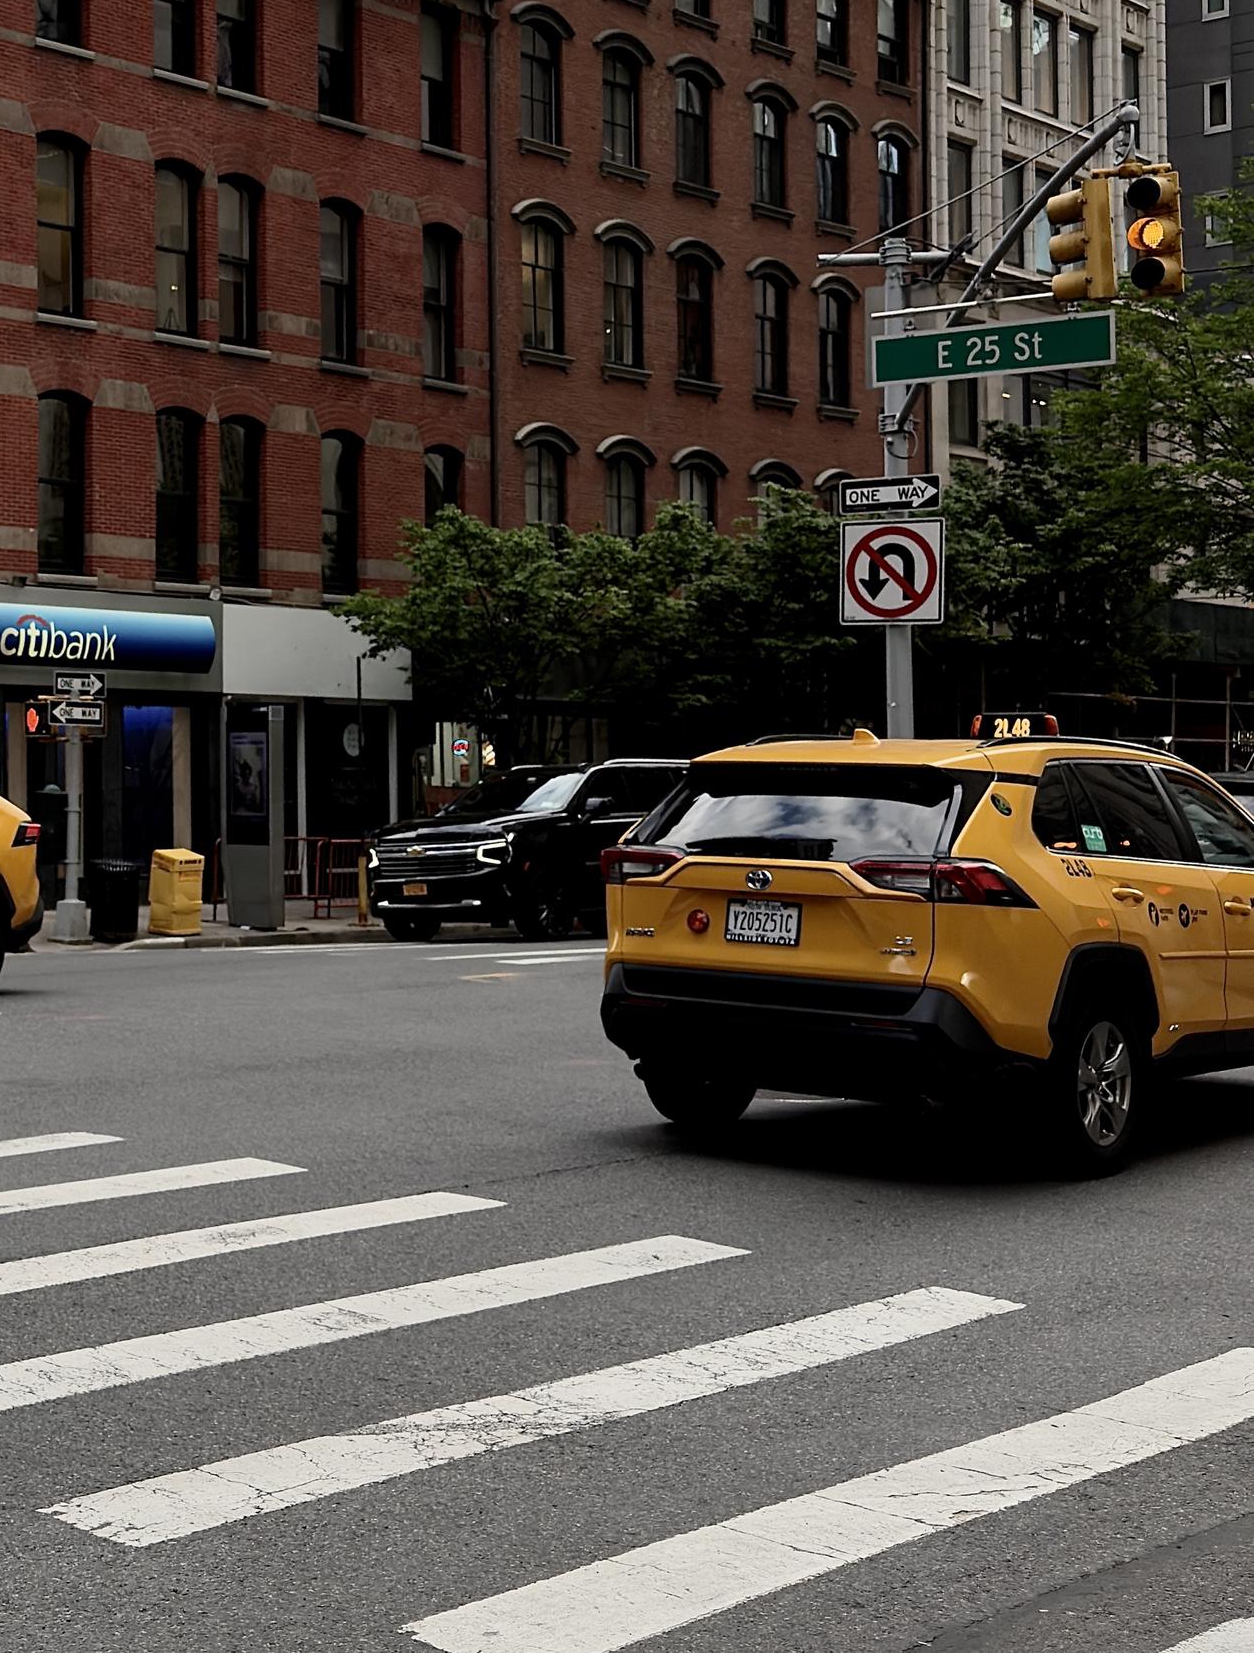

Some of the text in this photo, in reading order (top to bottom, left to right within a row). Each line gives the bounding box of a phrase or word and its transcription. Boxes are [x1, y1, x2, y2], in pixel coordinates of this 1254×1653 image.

[937, 330, 1043, 369] E 25 St
[849, 485, 929, 504] ONE WAY
[0, 620, 118, 662] citibank
[60, 678, 95, 689] ONE WAY
[59, 707, 97, 718] ONE WAY
[993, 717, 1032, 739] 2L48
[733, 910, 793, 934] Y205251C
